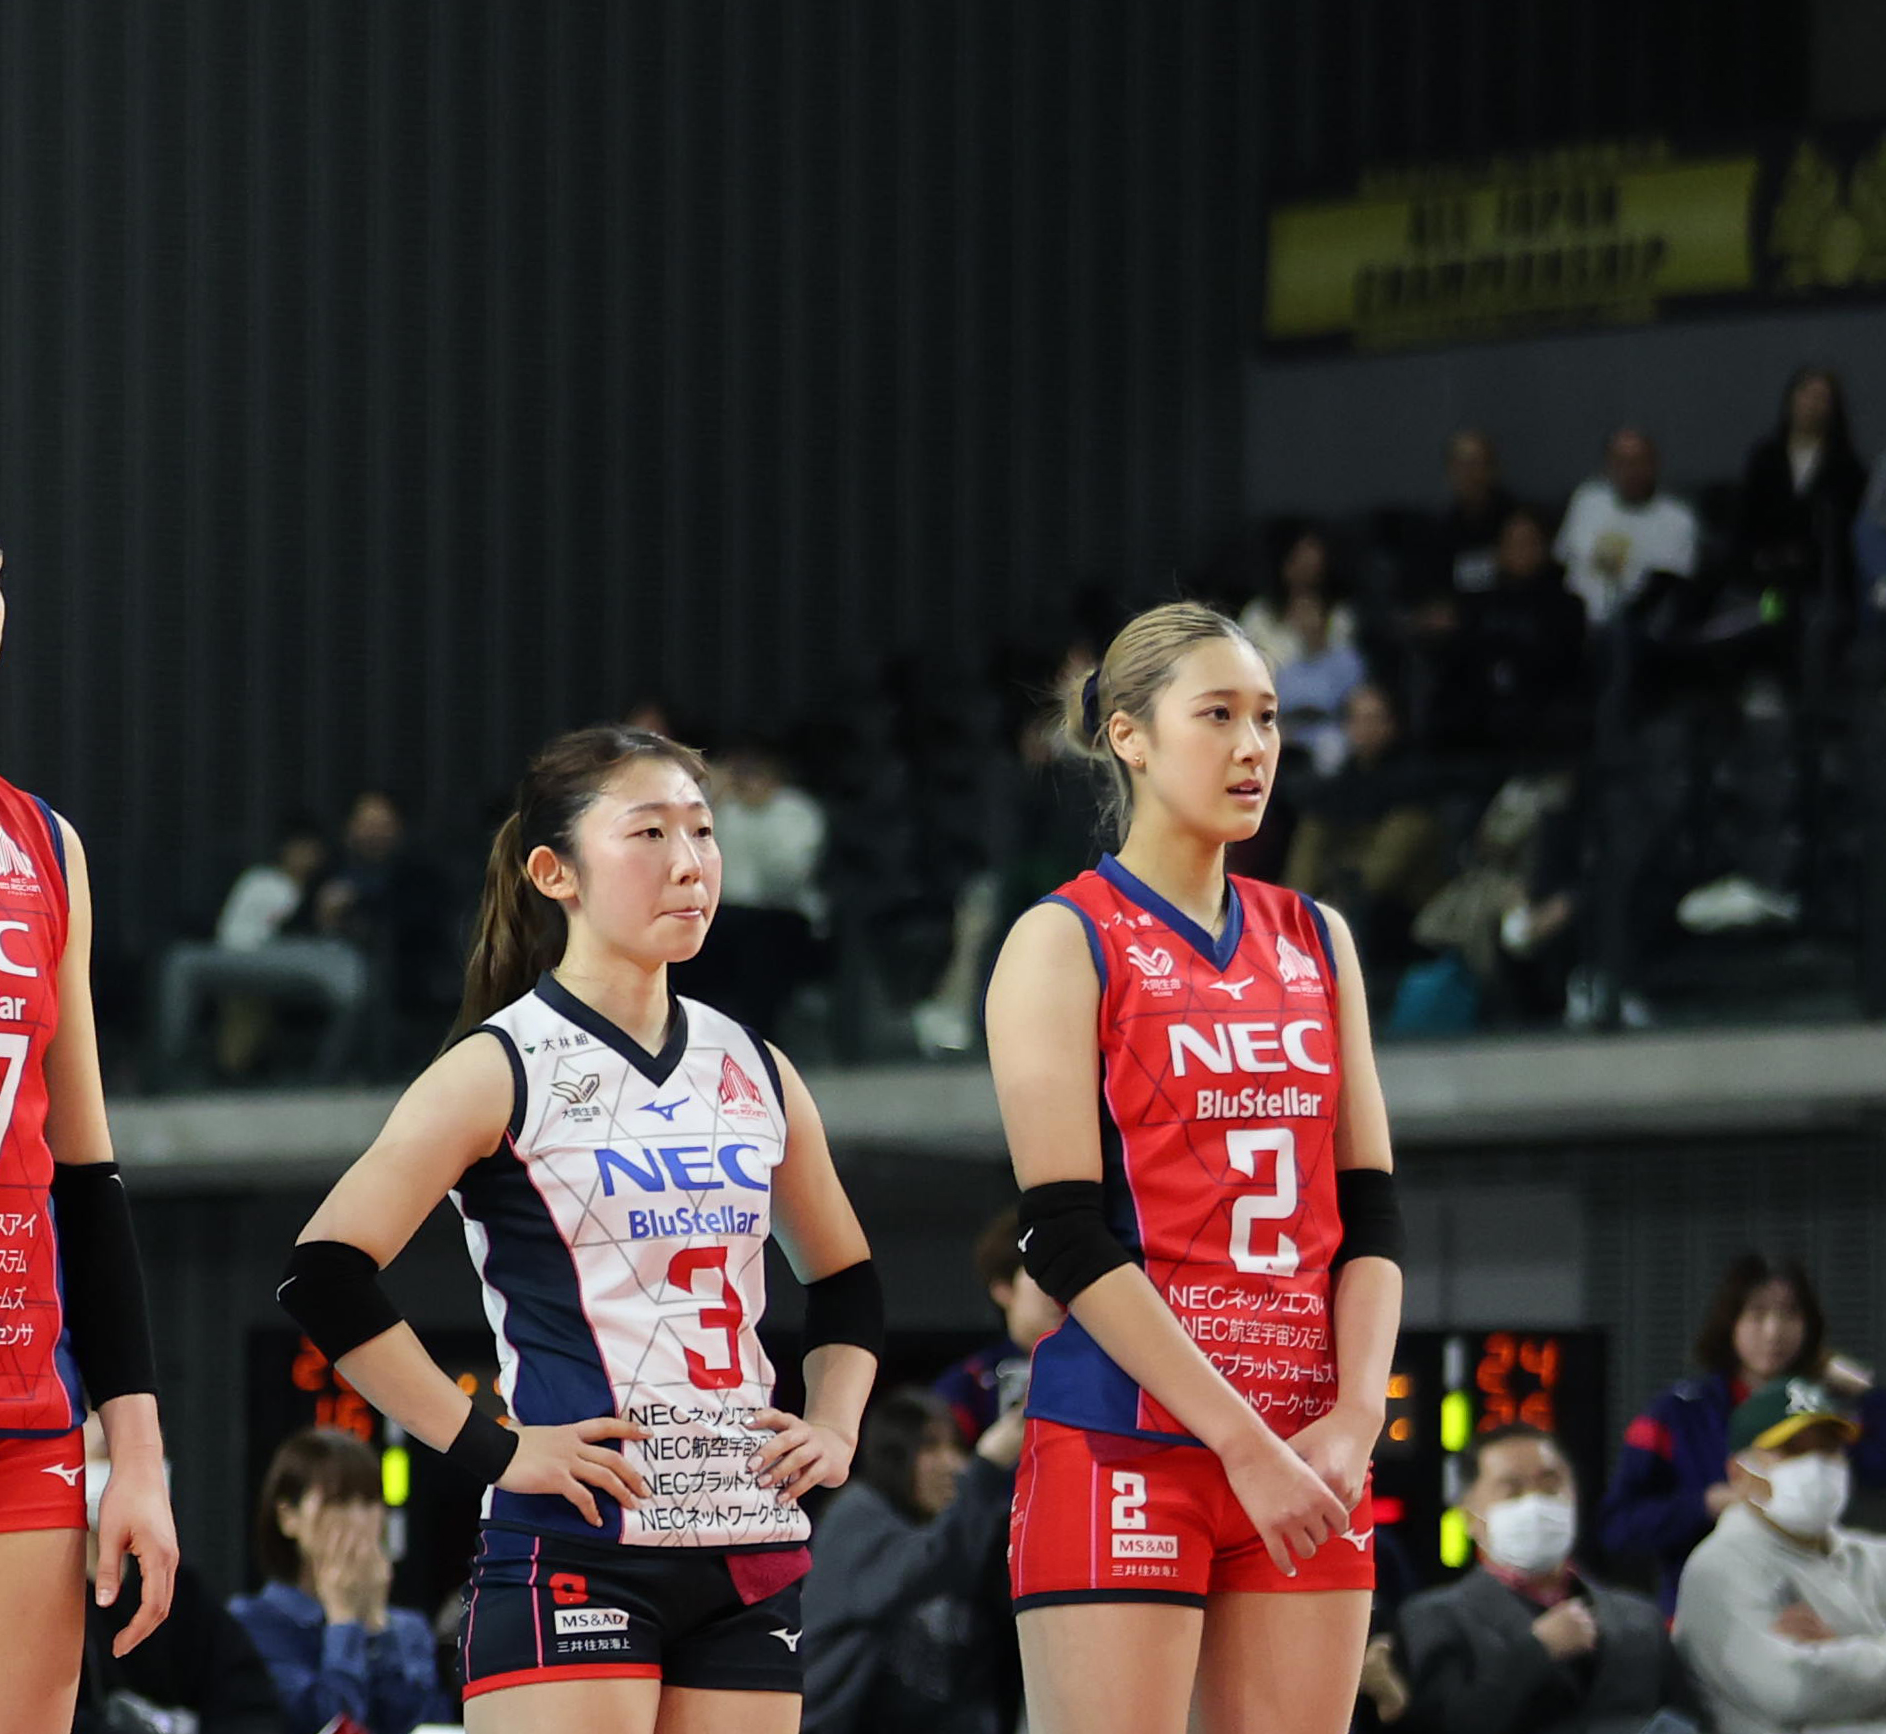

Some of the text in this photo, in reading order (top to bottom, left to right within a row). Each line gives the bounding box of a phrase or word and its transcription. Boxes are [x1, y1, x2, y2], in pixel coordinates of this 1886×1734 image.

[541, 1033, 589, 1051] 大林組
[1167, 1019, 1331, 1078] NEC
[1196, 1086, 1322, 1120] BluStellar
[594, 1143, 769, 1197] NEC
[1225, 1127, 1300, 1278] 2
[628, 1204, 760, 1240] BluStellar
[667, 1246, 744, 1390] 3
[1112, 1471, 1147, 1529] 2
[1119, 1540, 1174, 1554] MS&AD
[562, 1614, 624, 1628] MS&AD
[557, 1637, 631, 1653] 三井住友海上
